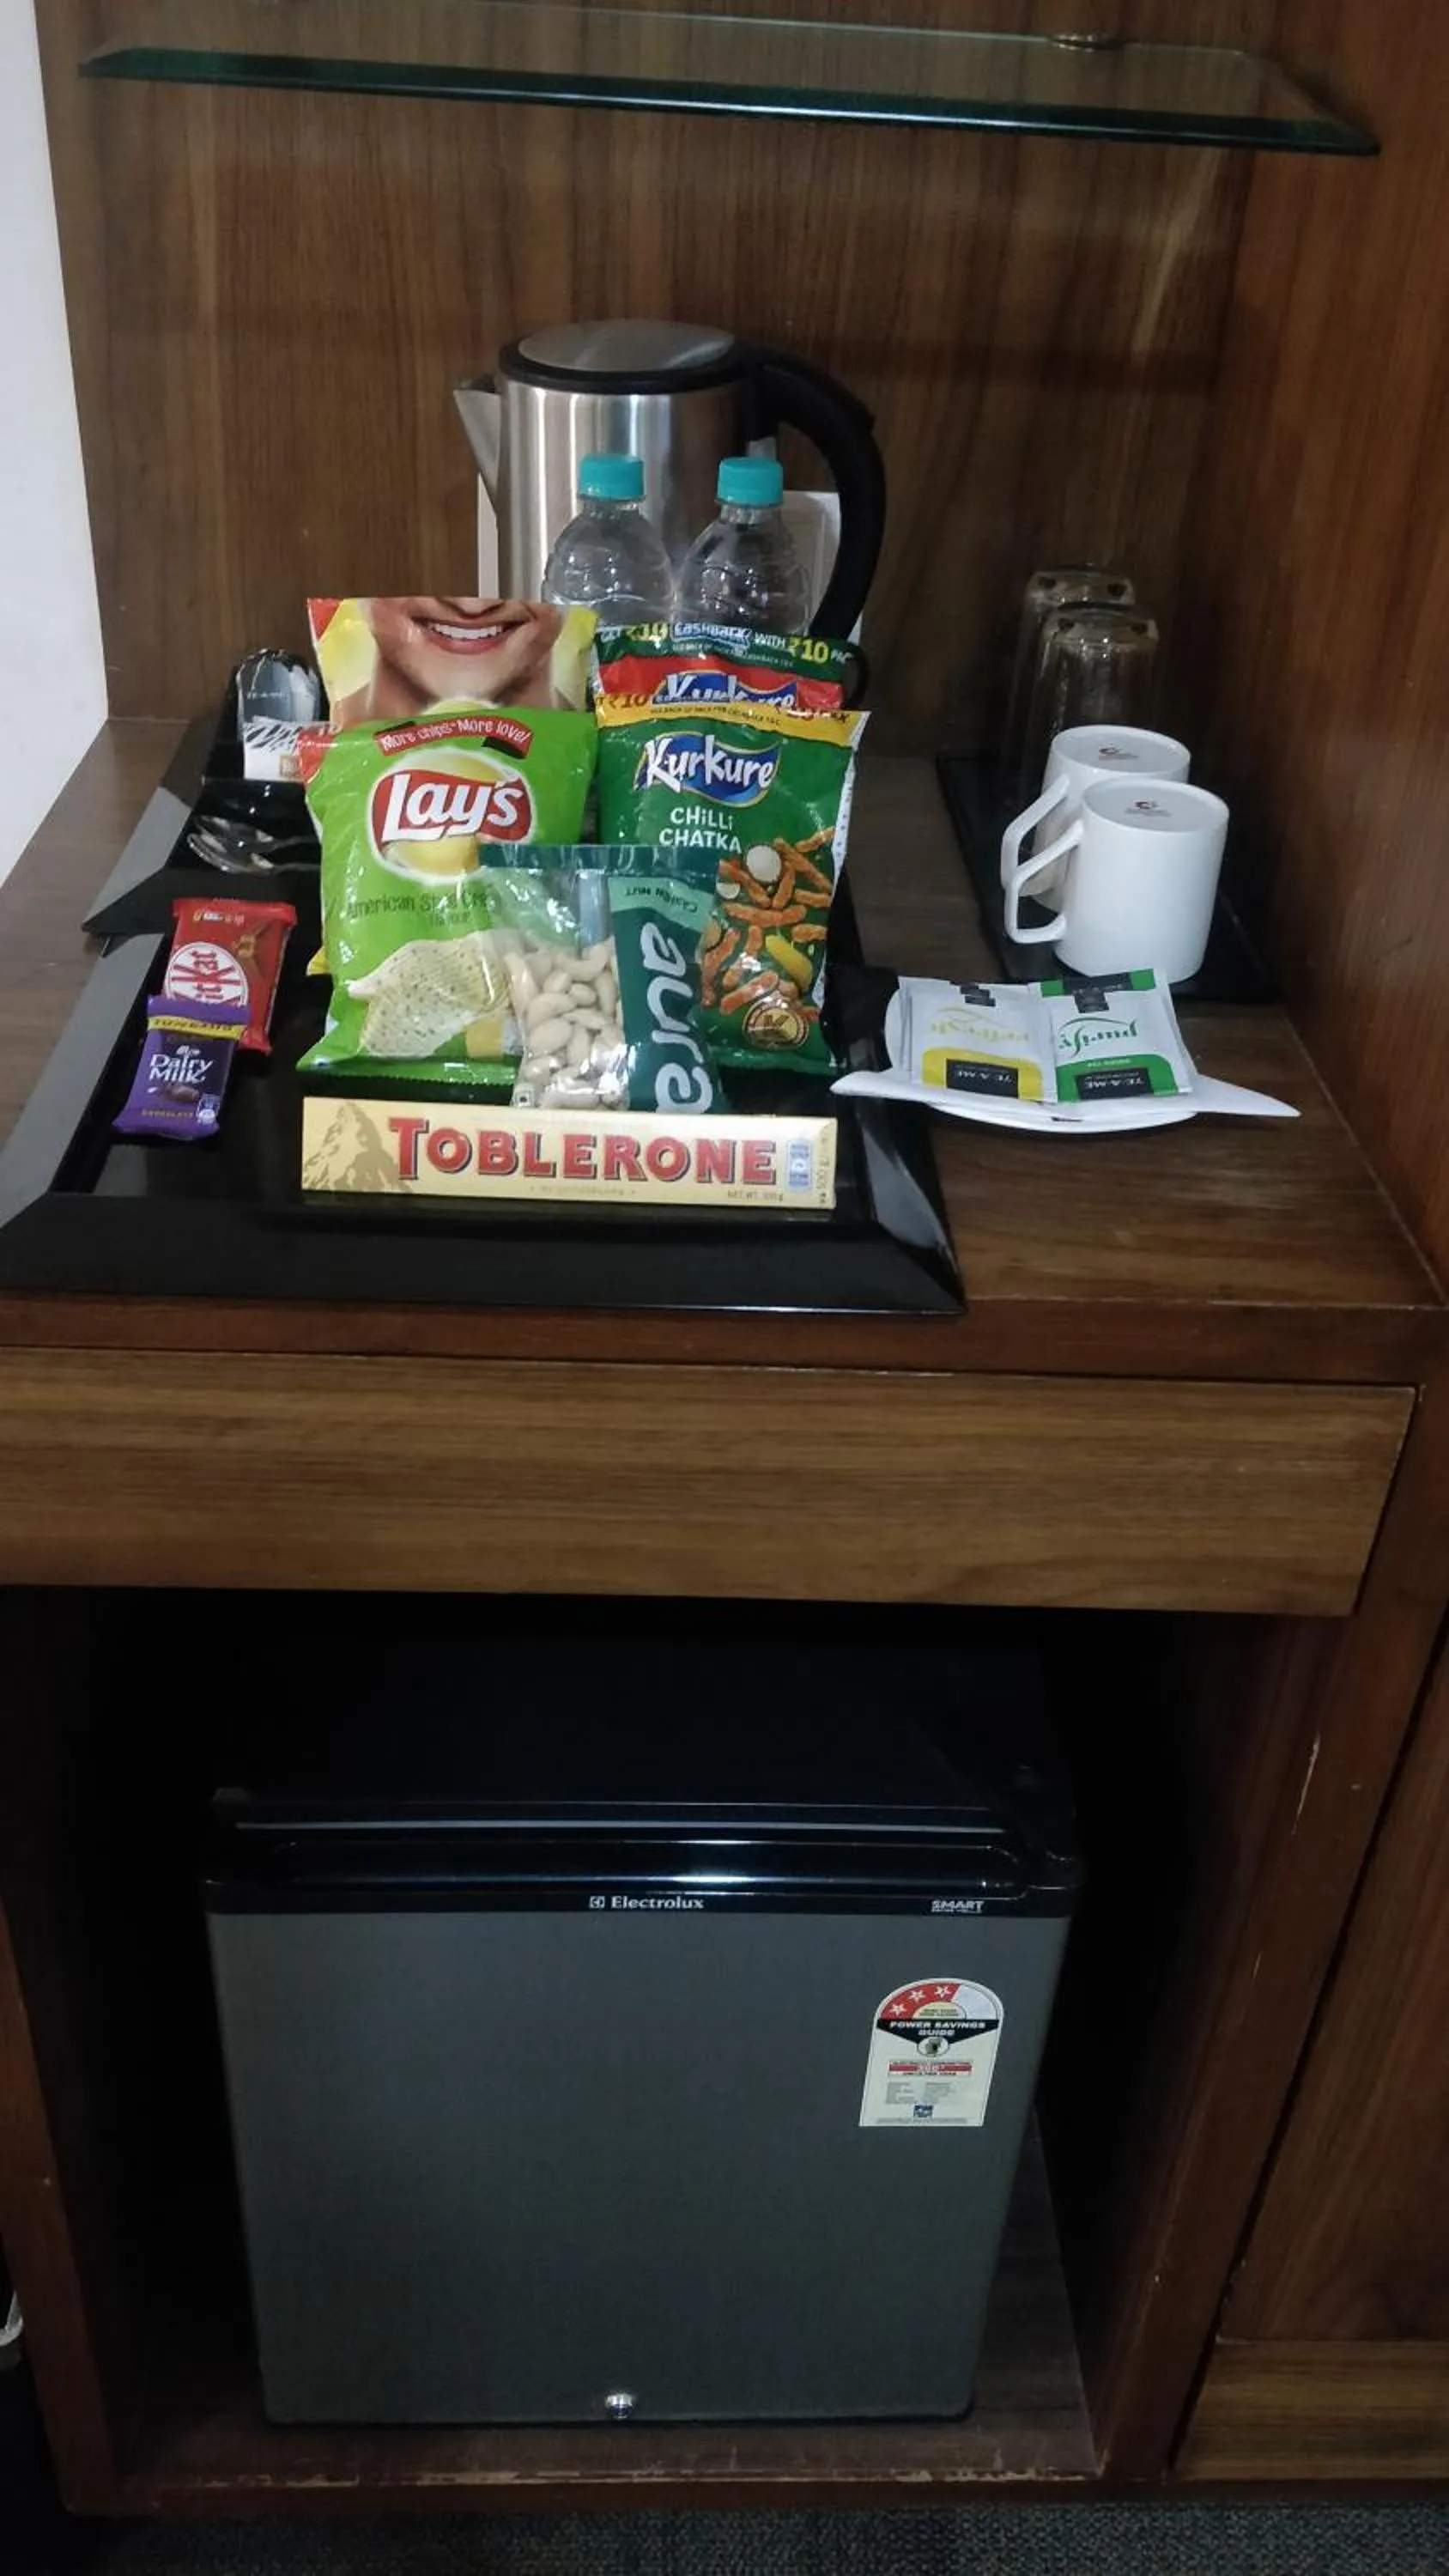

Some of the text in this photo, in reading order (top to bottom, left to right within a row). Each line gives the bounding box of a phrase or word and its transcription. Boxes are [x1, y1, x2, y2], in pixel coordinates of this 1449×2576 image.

[755, 631, 786, 649] WITH
[789, 635, 829, 663] ₹10
[380, 731, 416, 751] More
[457, 719, 493, 732] More
[496, 720, 531, 743] love!
[645, 735, 773, 793] Kurkure
[382, 774, 523, 841] Lay's
[659, 828, 743, 854] CHATKA
[640, 922, 712, 1114] aura
[149, 1053, 213, 1073] Dairy
[149, 1066, 206, 1084] Milk
[389, 1117, 777, 1185] TOBLERONE
[611, 1895, 704, 1909] Electrolux
[931, 1899, 985, 1910] SMART
[935, 2020, 985, 2029] SAVINGS
